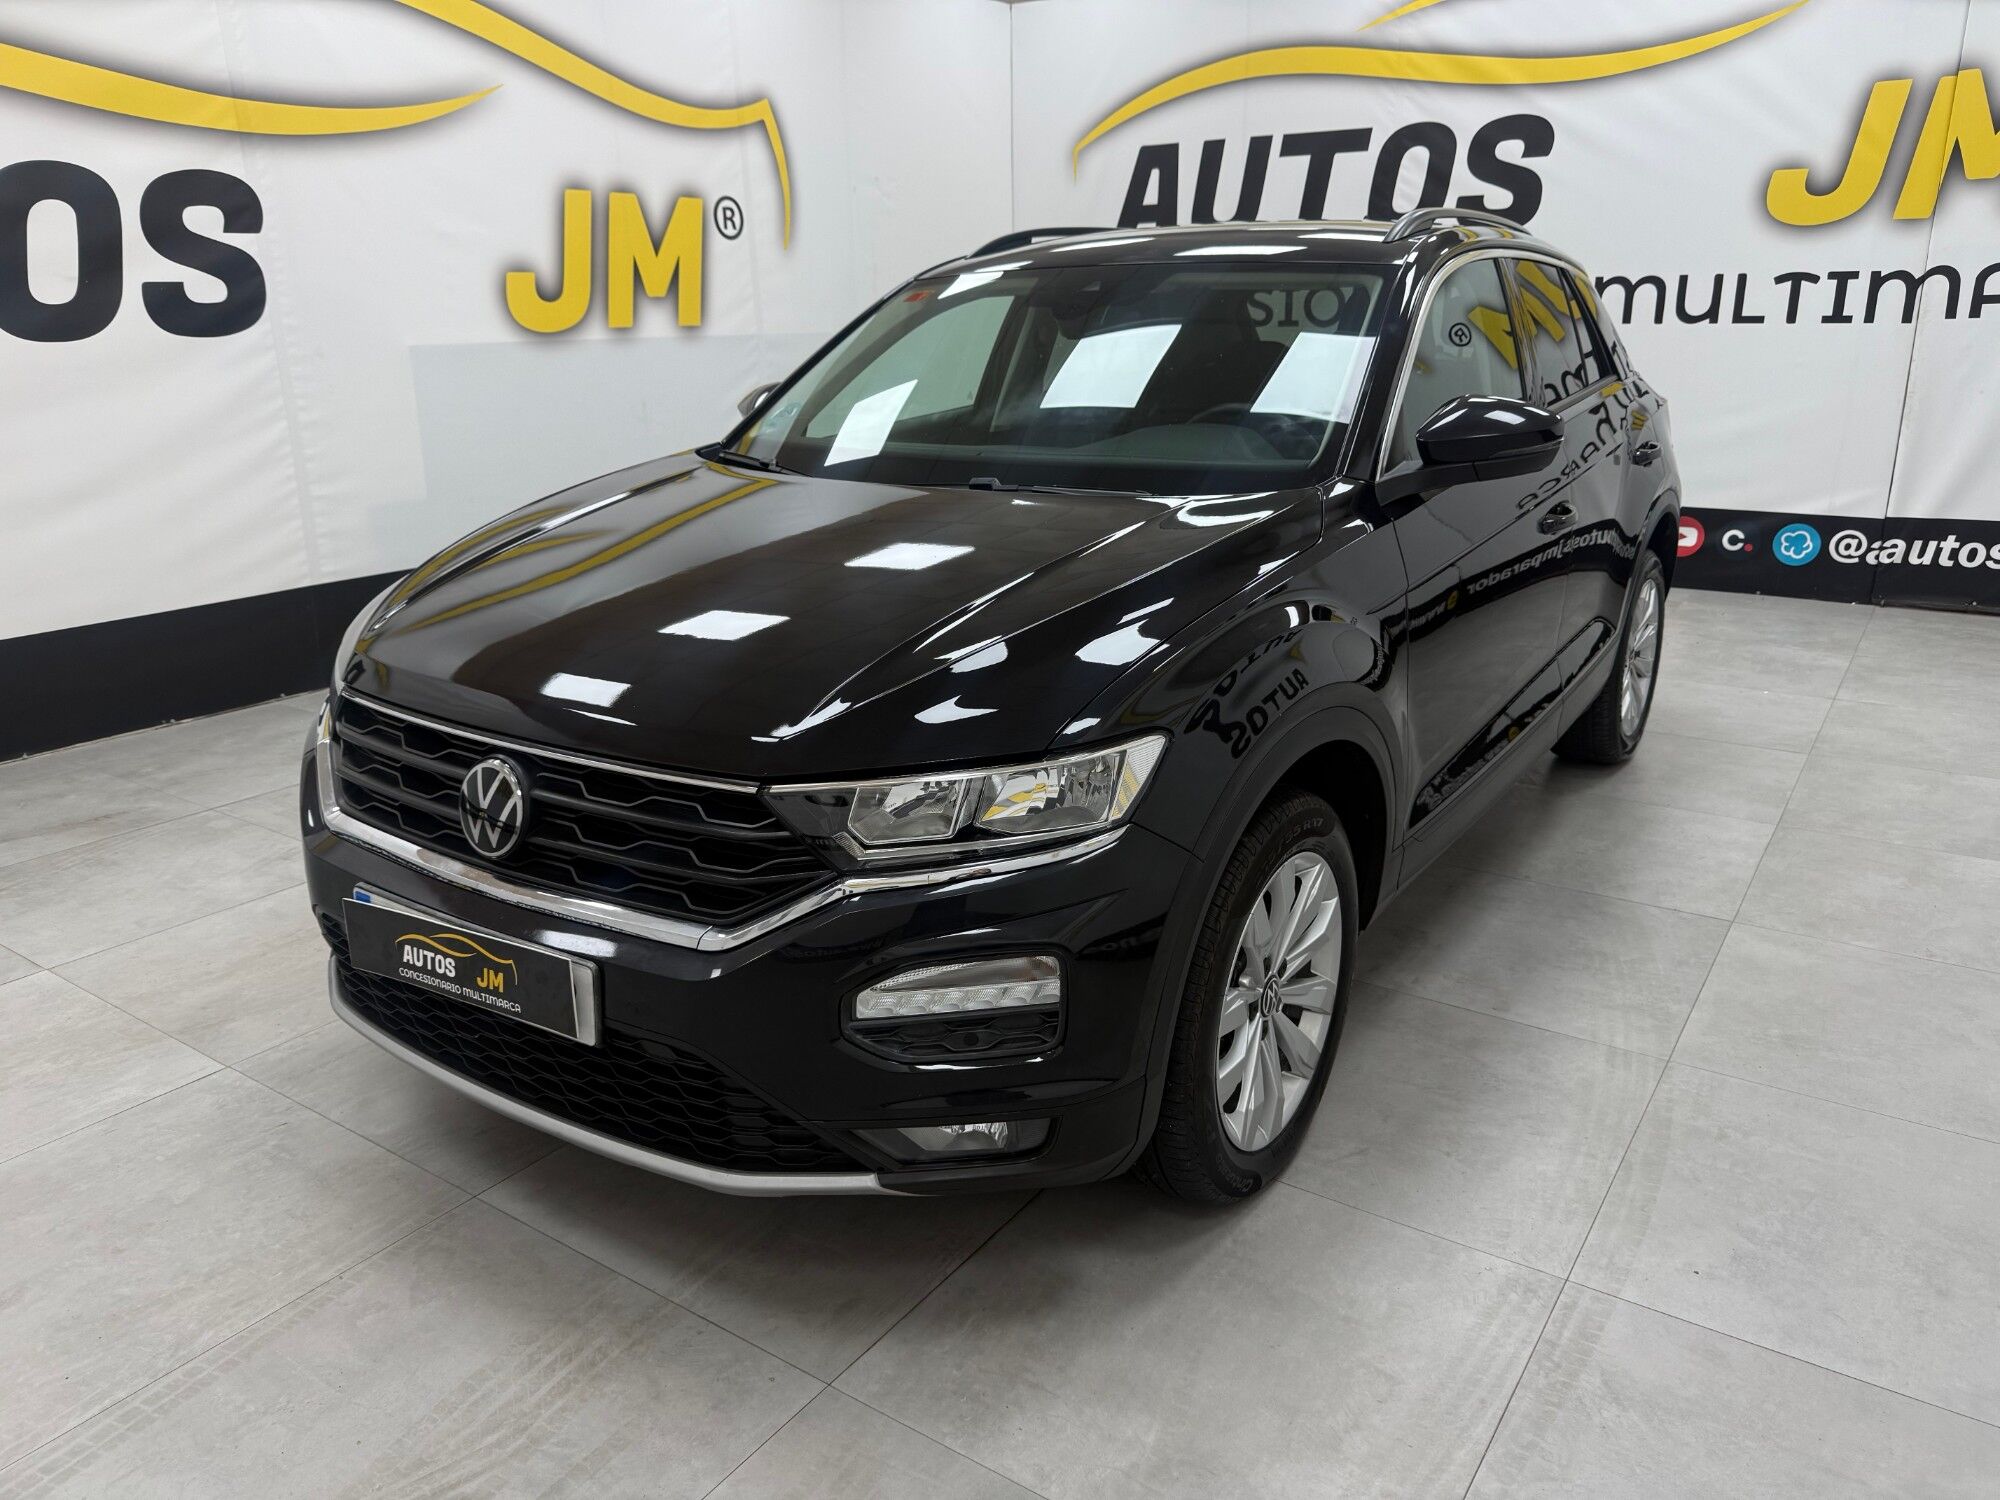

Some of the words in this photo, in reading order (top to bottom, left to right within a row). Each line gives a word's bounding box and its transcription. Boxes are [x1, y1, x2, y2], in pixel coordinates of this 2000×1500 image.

[1117, 114, 1555, 228] AUTOS
[1766, 68, 2000, 225] JM
[505, 189, 704, 333] JM
[402, 944, 456, 978] AUTOS
[477, 967, 504, 993] JM
